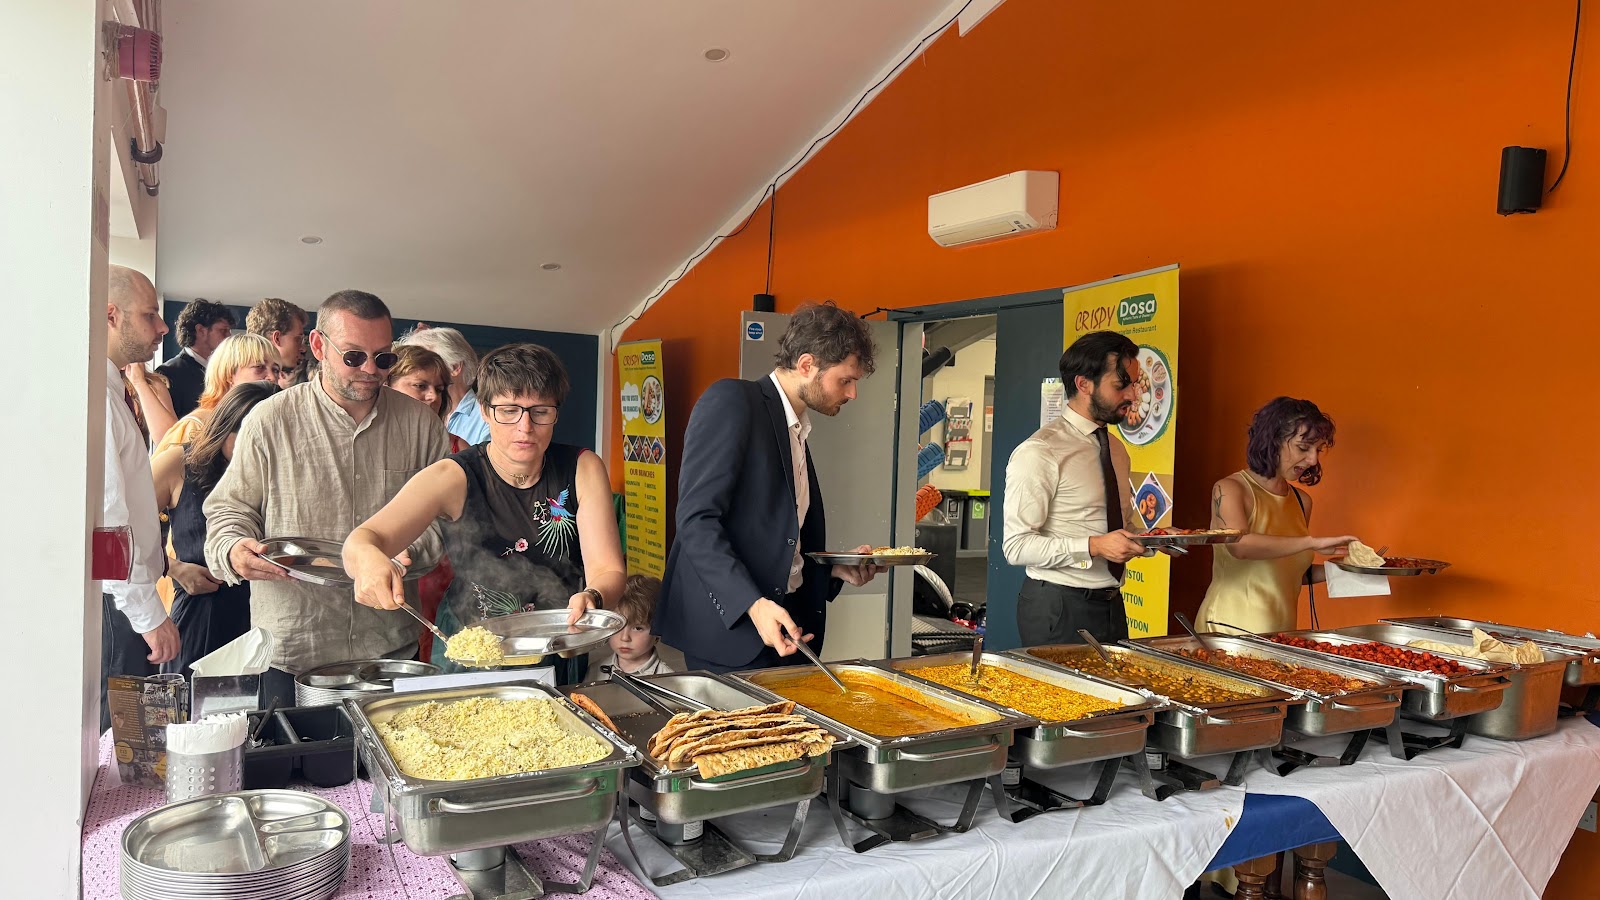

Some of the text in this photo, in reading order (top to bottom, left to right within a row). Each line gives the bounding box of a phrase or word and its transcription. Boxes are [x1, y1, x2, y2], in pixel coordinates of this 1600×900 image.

[1075, 300, 1155, 331] CRISPY Dosa
[1126, 568, 1144, 583] ISTOL
[1126, 616, 1149, 633] OYDON
